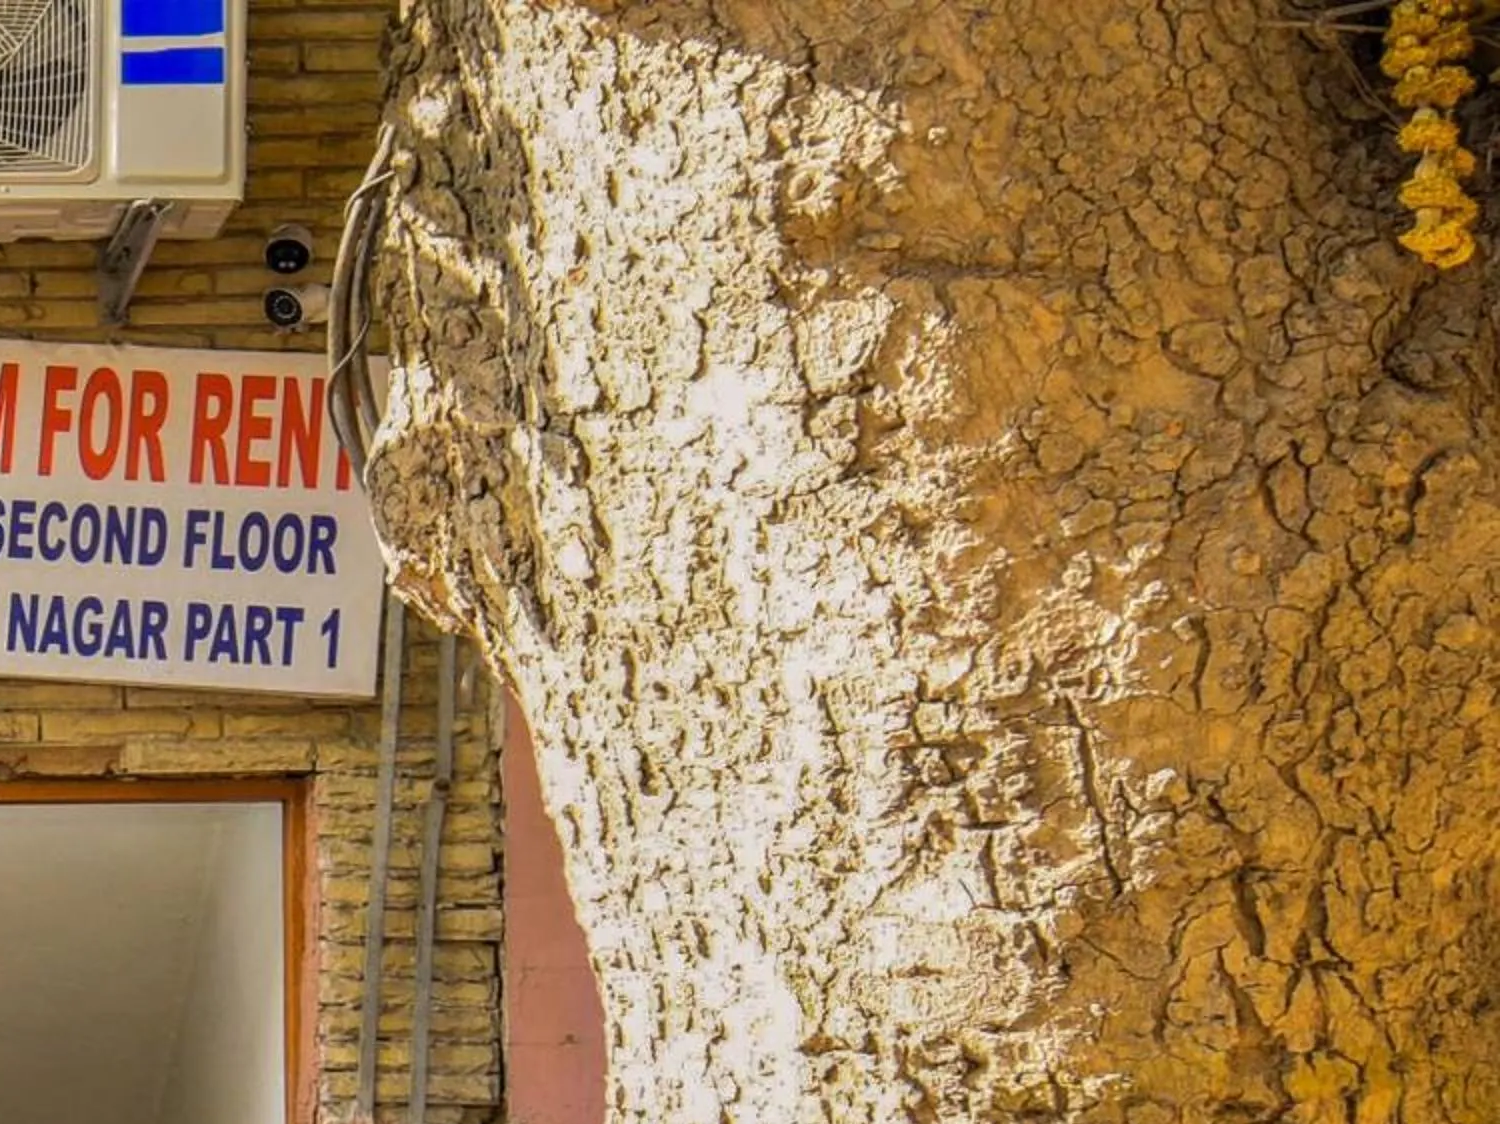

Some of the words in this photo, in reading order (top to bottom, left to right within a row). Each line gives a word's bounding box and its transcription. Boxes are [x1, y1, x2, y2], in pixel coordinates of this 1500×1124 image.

[38, 365, 169, 483] FOR
[189, 373, 361, 490] REN
[183, 510, 338, 575] FLOOR
[7, 592, 168, 661] NAGAR
[185, 603, 304, 667] PART
[320, 608, 342, 669] 1
